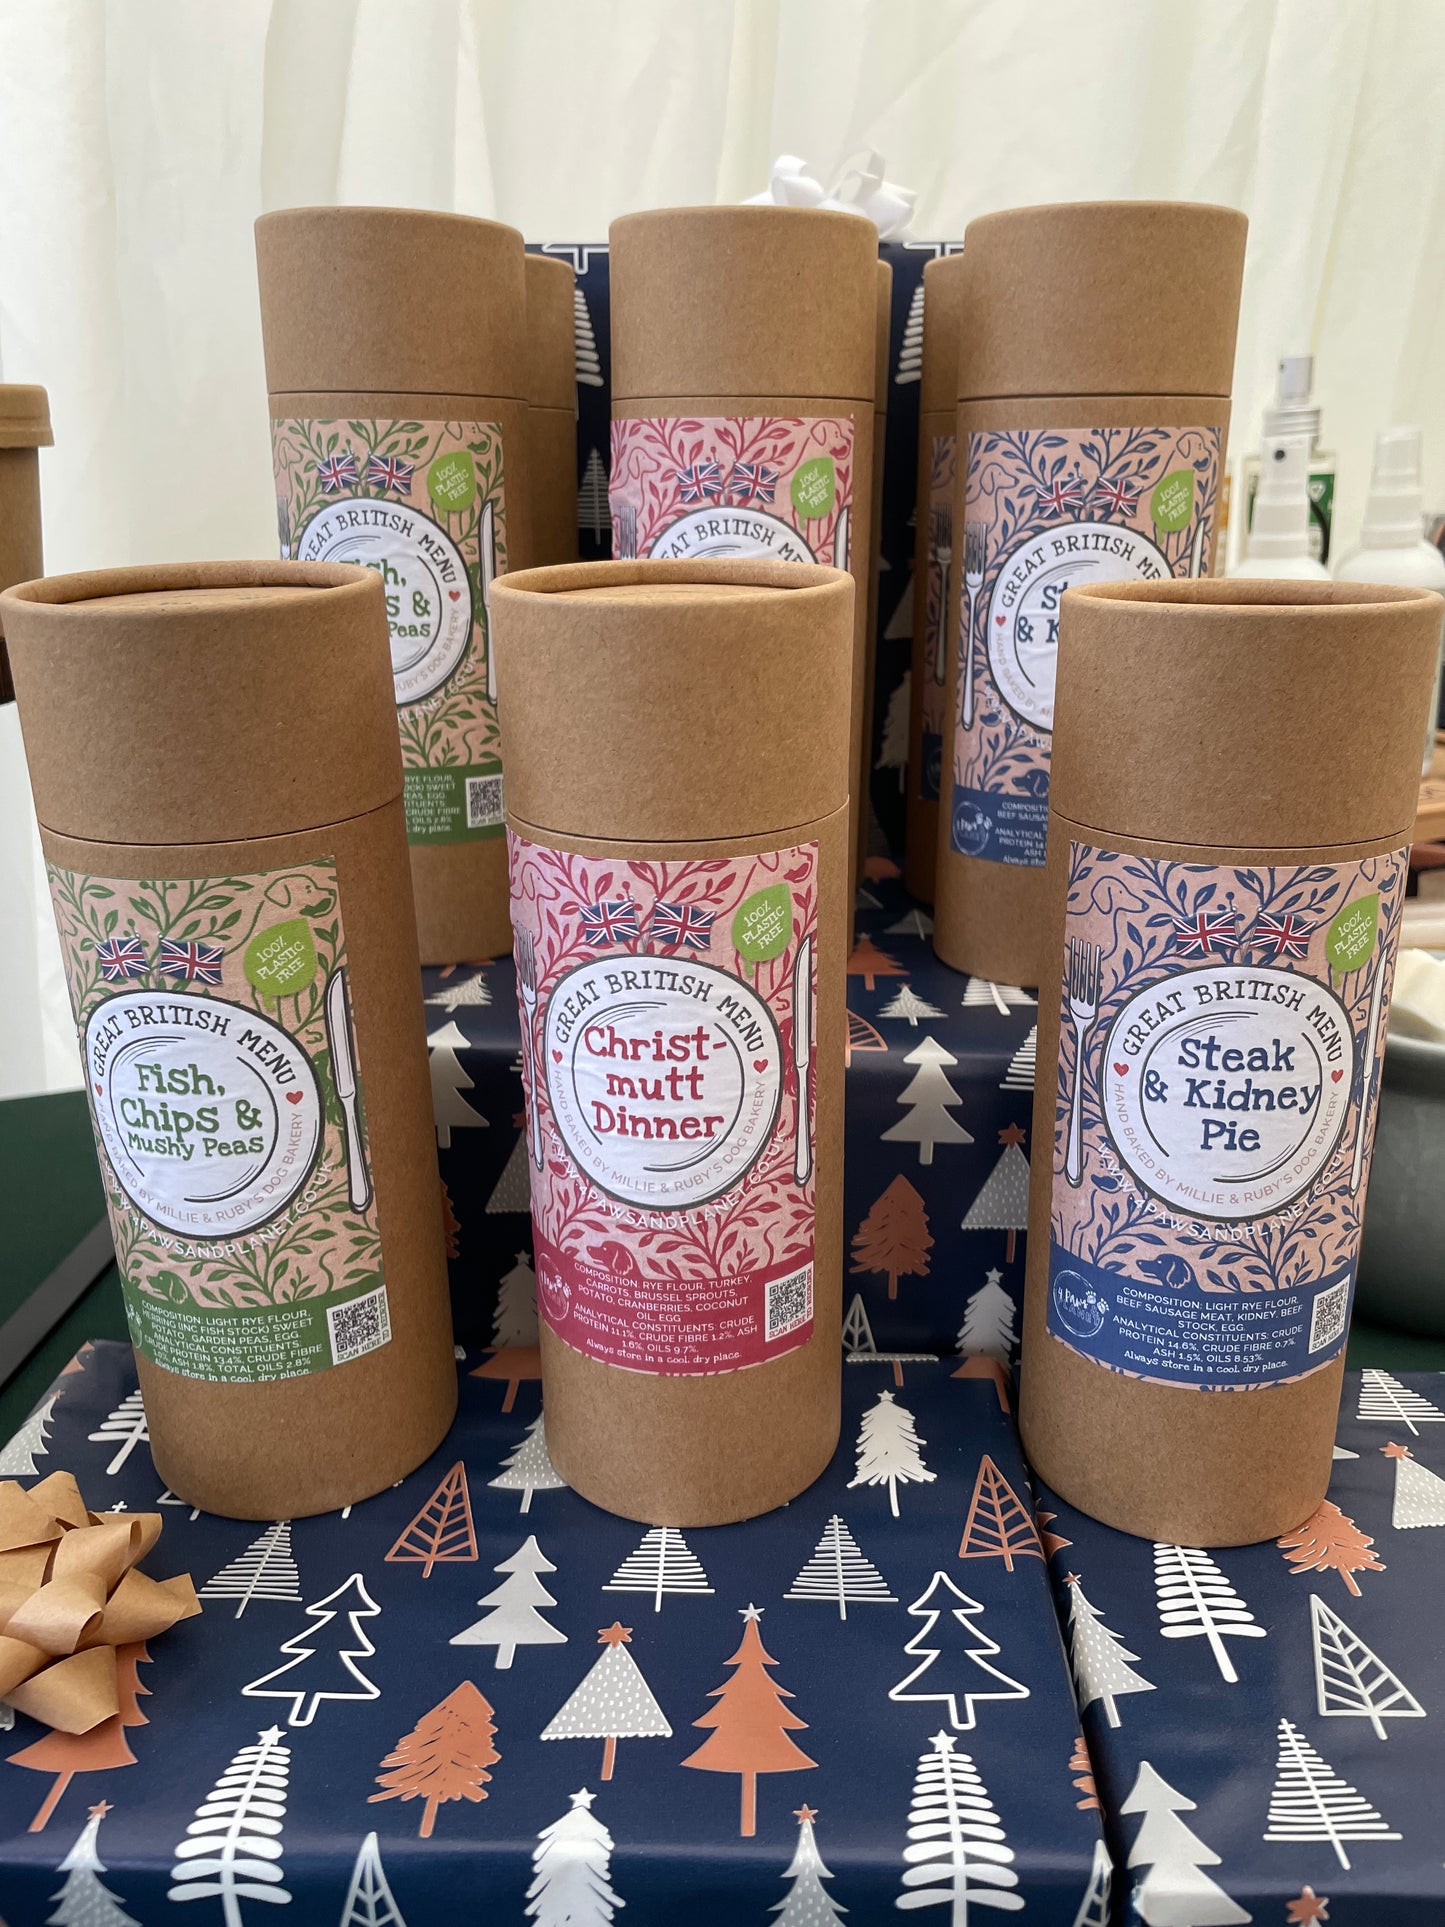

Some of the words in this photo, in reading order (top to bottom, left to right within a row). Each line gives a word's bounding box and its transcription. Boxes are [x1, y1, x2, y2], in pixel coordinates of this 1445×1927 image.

[435, 469, 469, 496] PLASTIC
[448, 483, 469, 501] FREE
[798, 476, 829, 503] PLASTIC
[809, 490, 829, 509] FREE
[1158, 488, 1190, 517] PLASTIC
[1168, 503, 1187, 522] FREE
[694, 518, 776, 546] BRITISH
[305, 522, 333, 562] REAT
[336, 509, 415, 538] BRITISH
[418, 534, 457, 584] MENU
[1001, 547, 1048, 608] GREAT
[1051, 533, 1136, 561] BRITISH
[741, 906, 785, 945] PLASTIC
[743, 900, 771, 927] 100%
[1338, 910, 1363, 937] 100%
[757, 922, 784, 949] FREE
[1335, 916, 1372, 956] PLASTIC
[1347, 933, 1370, 960] FREE
[256, 936, 287, 963] 100%
[256, 942, 304, 979] PLASTIC
[275, 957, 305, 983] FREE
[556, 980, 601, 1044] GREAT
[604, 970, 714, 1002] BRITISH
[716, 995, 765, 1052] MENU
[1122, 991, 1186, 1056] GREAT
[1193, 980, 1306, 1012] BRITISH
[1305, 1005, 1343, 1062] MENU
[94, 1015, 123, 1077] GREAT
[124, 1005, 231, 1036] BRITISH
[237, 1029, 297, 1085] MENU
[584, 1025, 727, 1061] Christ-
[1177, 1035, 1296, 1073] Steak
[134, 1063, 225, 1096] Fish,
[606, 1066, 704, 1100] mutt
[1144, 1069, 1168, 1103] &
[1183, 1078, 1321, 1114] Kidney
[120, 1098, 220, 1142] Chips
[235, 1099, 263, 1130] &
[554, 1069, 568, 1110] HAND
[566, 1113, 592, 1157] BAKED
[593, 1158, 609, 1174] BY
[611, 1171, 656, 1192] MILLIE
[660, 1182, 670, 1193] &
[674, 1163, 723, 1191] RUBY'S
[722, 1137, 747, 1164] DOG
[743, 1081, 766, 1134] BAKERY
[591, 1101, 725, 1140] Dinner
[127, 1132, 195, 1161] Mushy
[203, 1136, 264, 1157] Peas
[1114, 1083, 1129, 1123] HAND
[1124, 1127, 1155, 1169] BAKED
[1155, 1169, 1175, 1185] BY
[1176, 1182, 1225, 1204] MILLIE
[1229, 1194, 1239, 1204] &
[1244, 1174, 1293, 1202] RUBY'S
[1293, 1147, 1318, 1175] DOG
[1315, 1091, 1339, 1145] BAKERY
[1200, 1118, 1261, 1151] Pie
[112, 1146, 138, 1188] BAKED
[139, 1189, 154, 1205] BY
[156, 1201, 199, 1223] MILLIE
[216, 1193, 264, 1224] RUBY'S
[262, 1167, 288, 1194] DOG
[282, 1112, 303, 1164] BAKERY
[634, 1291, 683, 1302] BRUSSEL
[642, 1281, 663, 1291] RYE
[574, 1302, 629, 1327] ANALYTICAL
[720, 1315, 755, 1329] CRUDE
[696, 1296, 749, 1311] COCONUT
[1116, 1295, 1143, 1309] BEEF
[1145, 1303, 1197, 1320] SAUSAGE
[1280, 1304, 1303, 1317] BEEF
[1206, 1302, 1238, 1311] LIGHT
[1242, 1301, 1262, 1311] RYE
[142, 1309, 176, 1329] HERRING
[200, 1326, 224, 1334] FISH
[227, 1326, 269, 1335] STOCK)
[273, 1317, 313, 1330] SWEET
[206, 1317, 238, 1326] LIGHT
[242, 1317, 264, 1326] RYE
[573, 1310, 609, 1332] PROTEIN
[639, 1333, 675, 1343] CRUDE
[678, 1334, 709, 1343] FIBRE
[737, 1325, 758, 1337] ASH
[658, 1313, 681, 1322] EGG
[1113, 1315, 1179, 1338] ANALYTICAL
[1271, 1324, 1303, 1339] CRUDE
[153, 1332, 208, 1353] ANALYTICAL
[170, 1347, 210, 1362] PROTEIN
[247, 1352, 287, 1363] CRUDE
[290, 1344, 323, 1358] FIBRE
[192, 1335, 236, 1345] GARDEN
[586, 1338, 614, 1354] Always
[617, 1348, 642, 1361] store
[645, 1353, 654, 1362] in
[693, 1354, 711, 1364] dry
[647, 1344, 671, 1353] OILS
[1119, 1327, 1164, 1346] PROTEIN
[1202, 1343, 1240, 1353] CRUDE
[1243, 1342, 1272, 1352] FIBRE
[172, 1357, 190, 1367] ASH
[217, 1364, 254, 1373] TOTAL
[257, 1362, 283, 1372] OILS
[1124, 1350, 1159, 1366] Always
[1161, 1360, 1190, 1371] store
[1193, 1364, 1203, 1372] in
[1243, 1364, 1260, 1373] dry
[1153, 1347, 1176, 1358] ASH
[1206, 1354, 1231, 1363] OILS
[182, 1369, 205, 1380] store
[208, 1373, 218, 1382] in
[258, 1372, 276, 1383] dry
